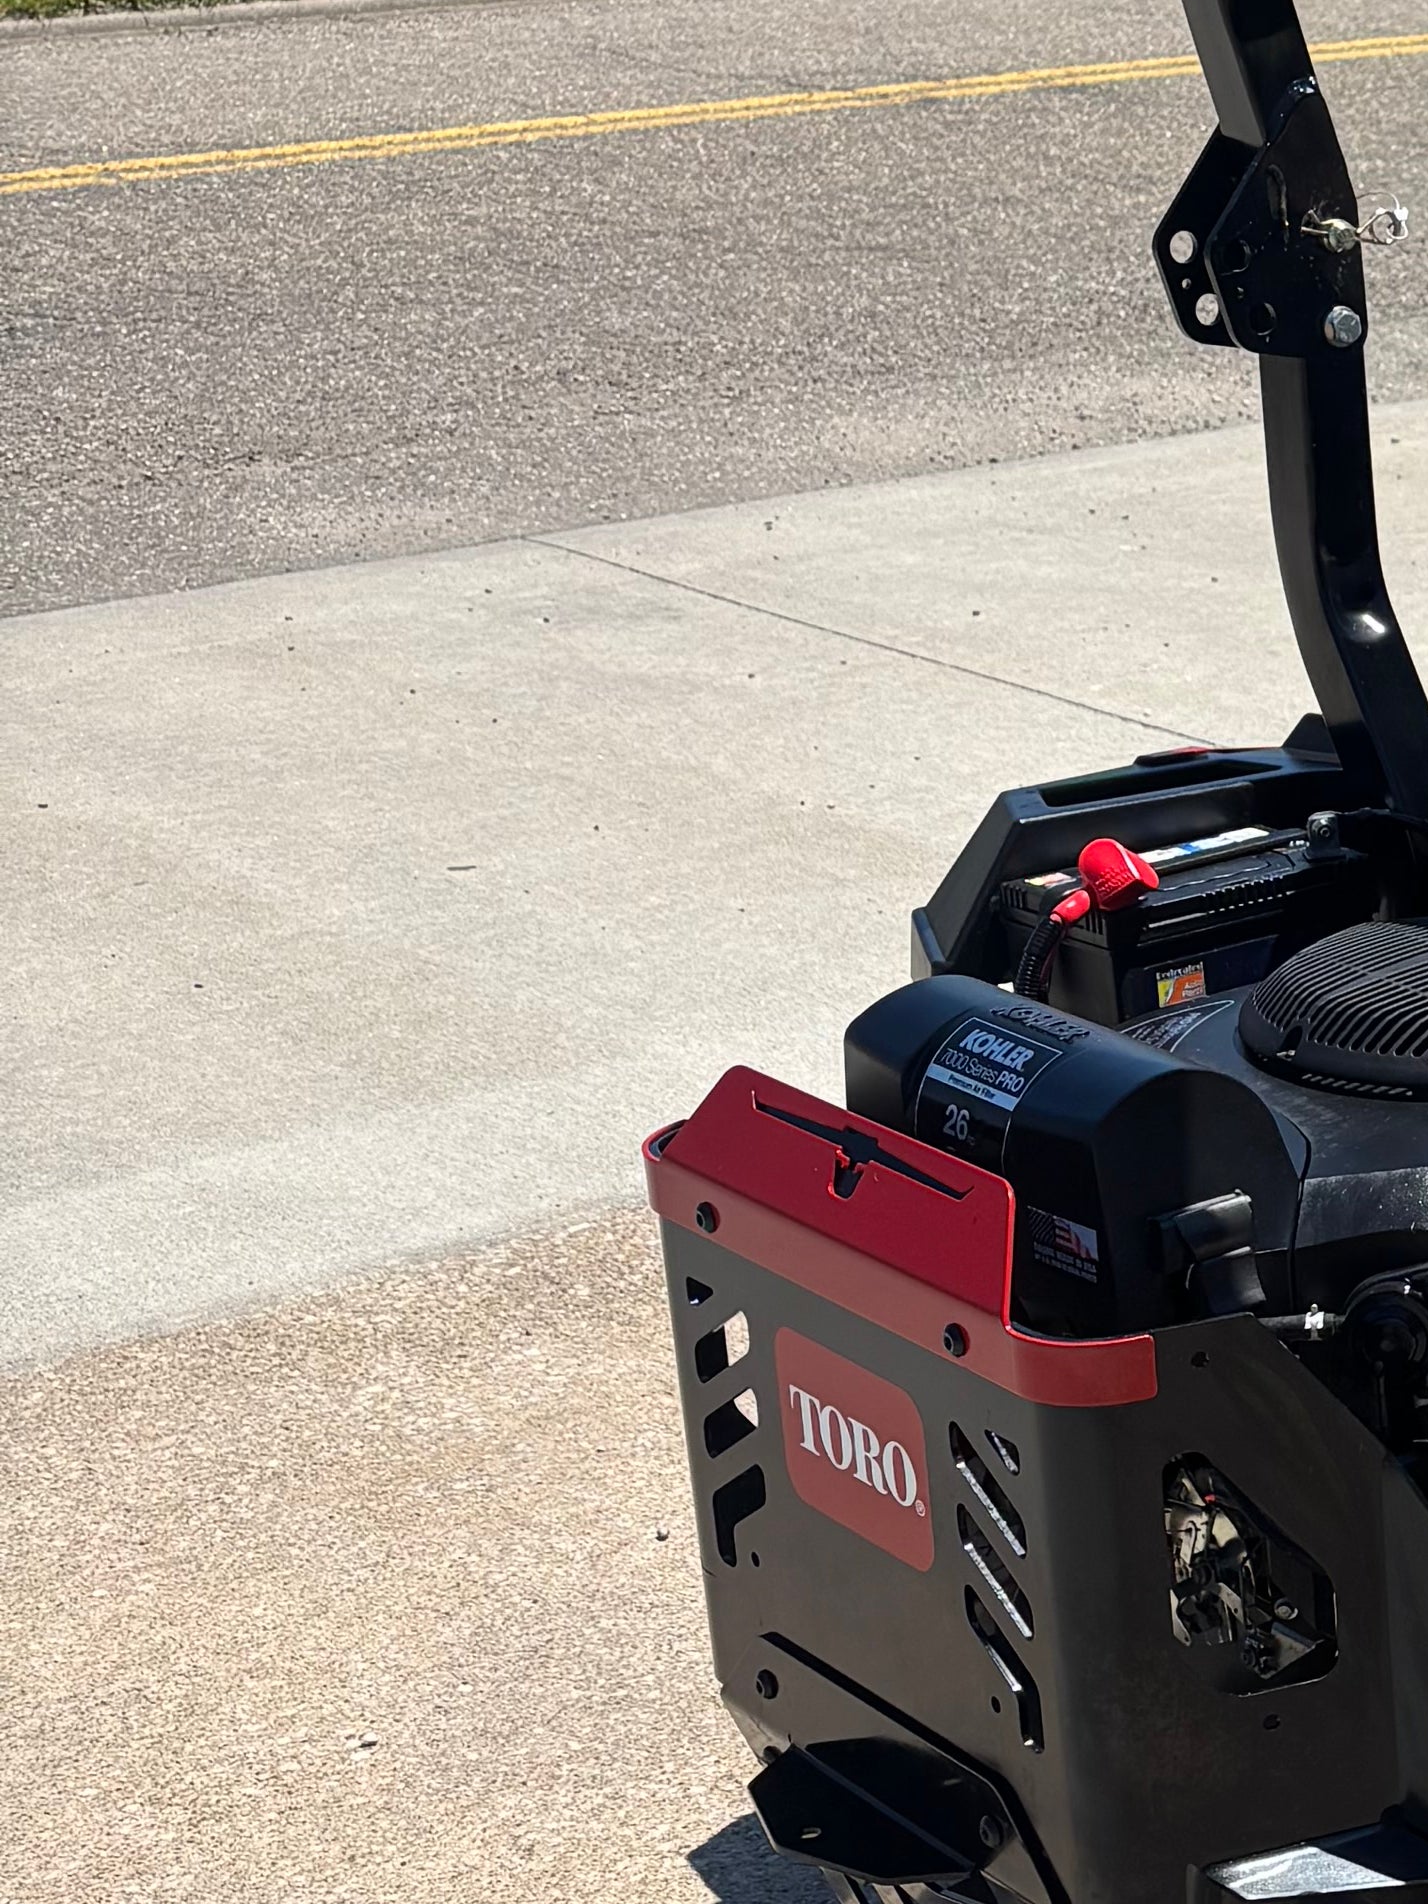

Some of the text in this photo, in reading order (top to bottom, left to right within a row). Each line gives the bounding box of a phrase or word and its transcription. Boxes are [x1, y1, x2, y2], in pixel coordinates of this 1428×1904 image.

[940, 1047, 1025, 1093] 7000 Series PRO
[959, 1028, 1035, 1072] KOHLER
[942, 1103, 970, 1142] 26
[789, 1383, 917, 1507] TORO
